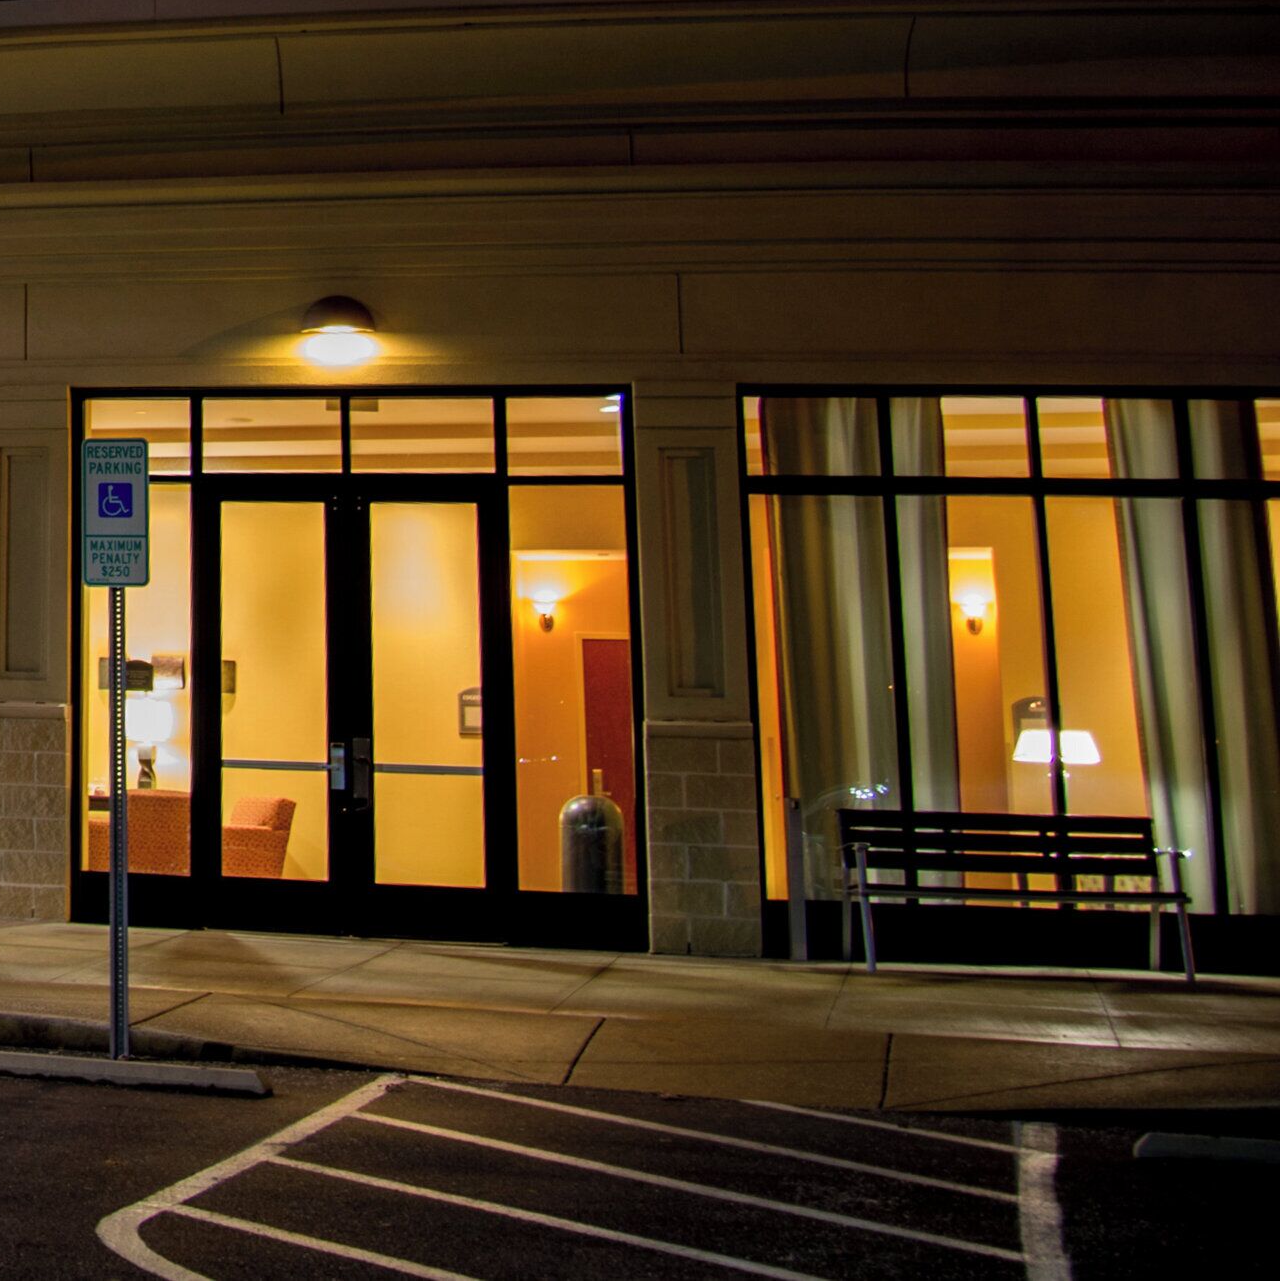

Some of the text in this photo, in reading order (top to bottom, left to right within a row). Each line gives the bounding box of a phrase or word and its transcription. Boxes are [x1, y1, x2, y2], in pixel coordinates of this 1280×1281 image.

[87, 446, 143, 459] RESERVED
[88, 462, 142, 475] PARKING
[90, 540, 142, 551] MAXIMUM
[92, 552, 140, 564] PENALTY
[101, 566, 130, 577] $250
